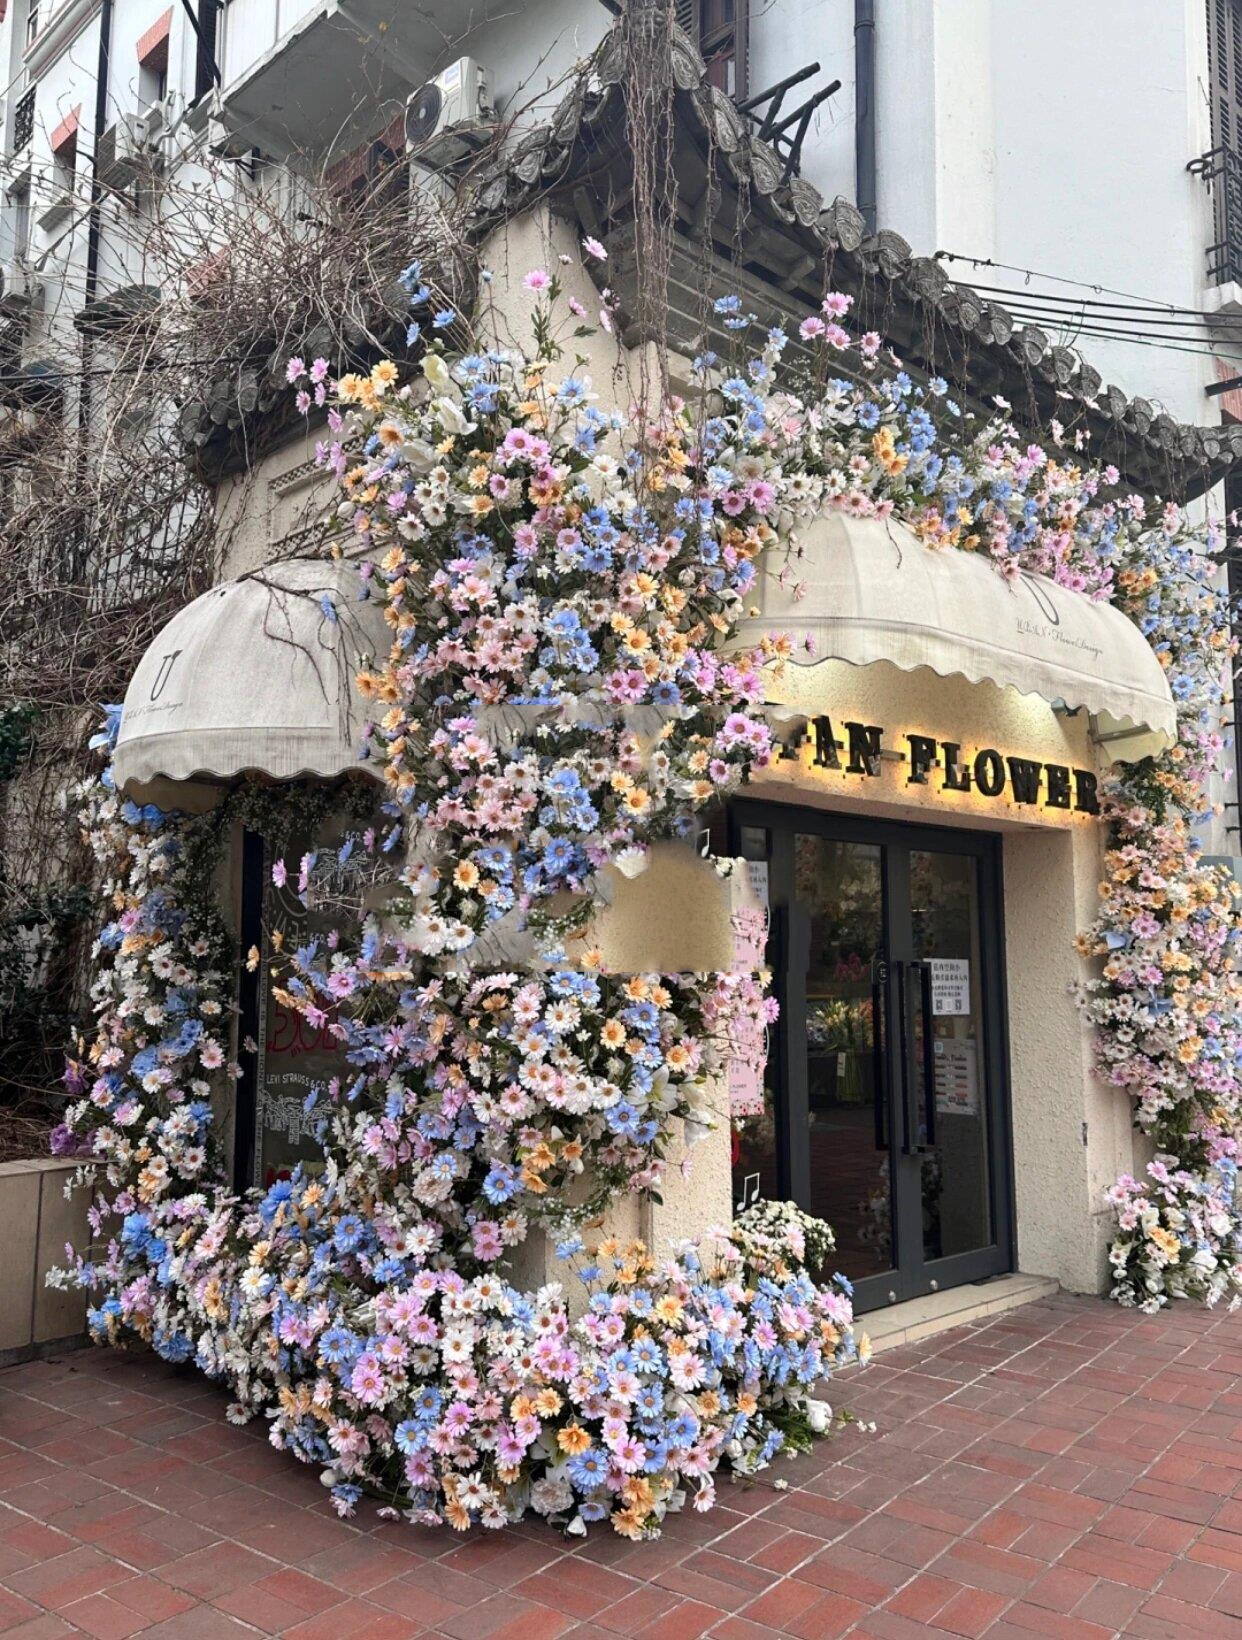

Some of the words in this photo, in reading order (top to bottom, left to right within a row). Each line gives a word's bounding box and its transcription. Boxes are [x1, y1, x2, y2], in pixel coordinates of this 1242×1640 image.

[906, 733, 1101, 816] FLOWER
[266, 1073, 281, 1085] LEVI
[282, 1072, 310, 1087] STRAUSS
